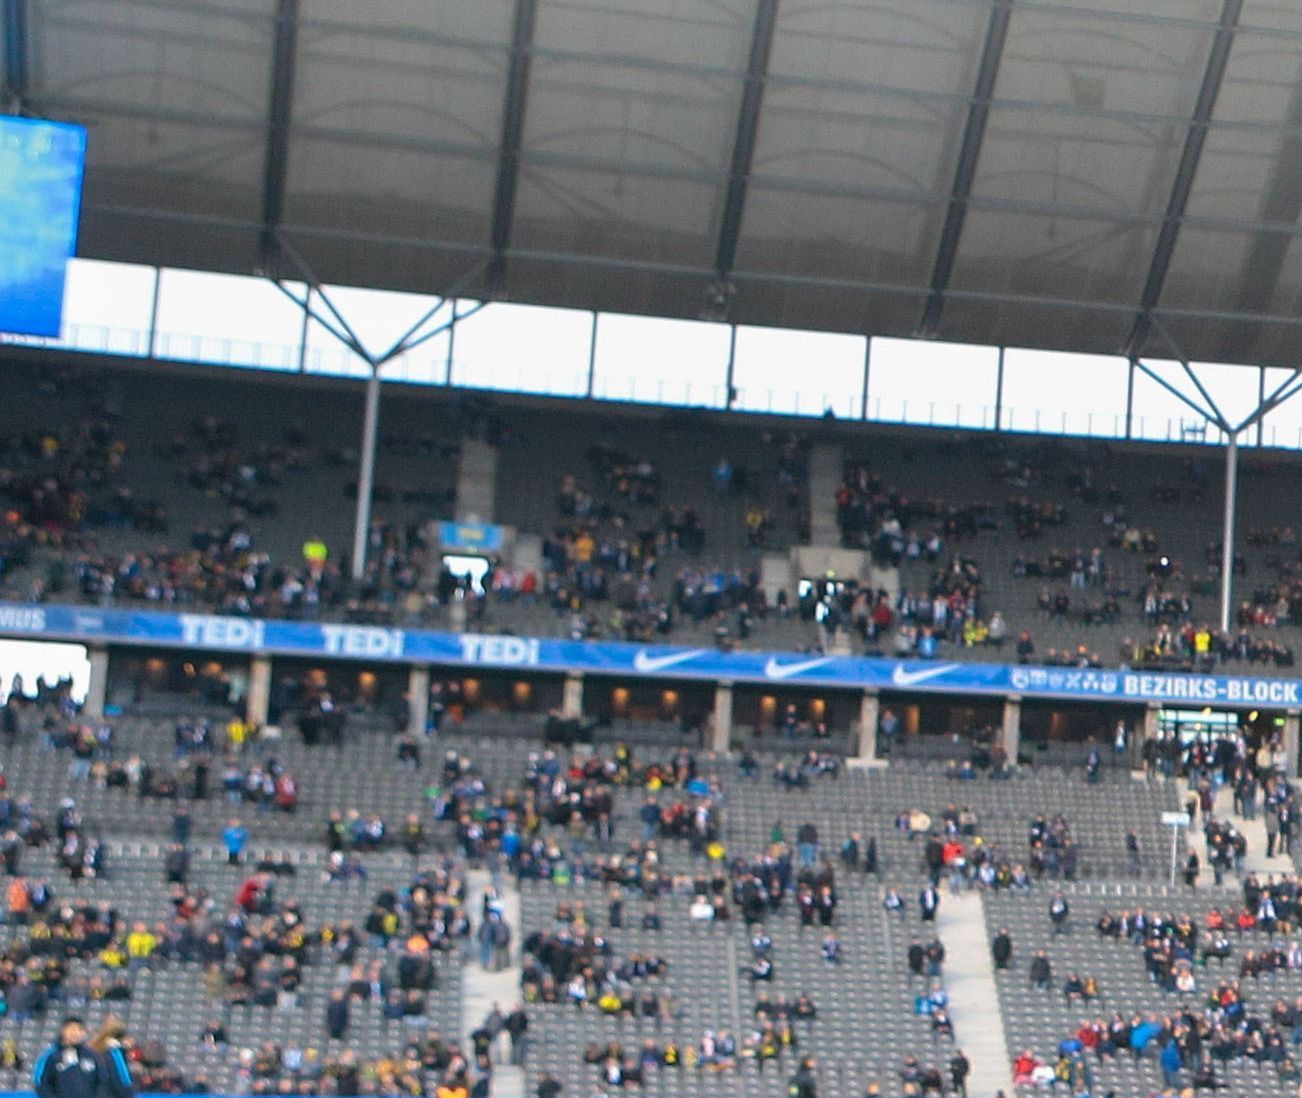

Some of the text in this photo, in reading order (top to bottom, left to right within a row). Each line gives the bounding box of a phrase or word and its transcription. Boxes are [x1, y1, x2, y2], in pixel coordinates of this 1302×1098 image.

[178, 613, 265, 648] TEDi
[320, 623, 404, 657] TEDi
[458, 633, 540, 665] TEDi
[1124, 674, 1299, 701] BEZIRKS-BLOCK
